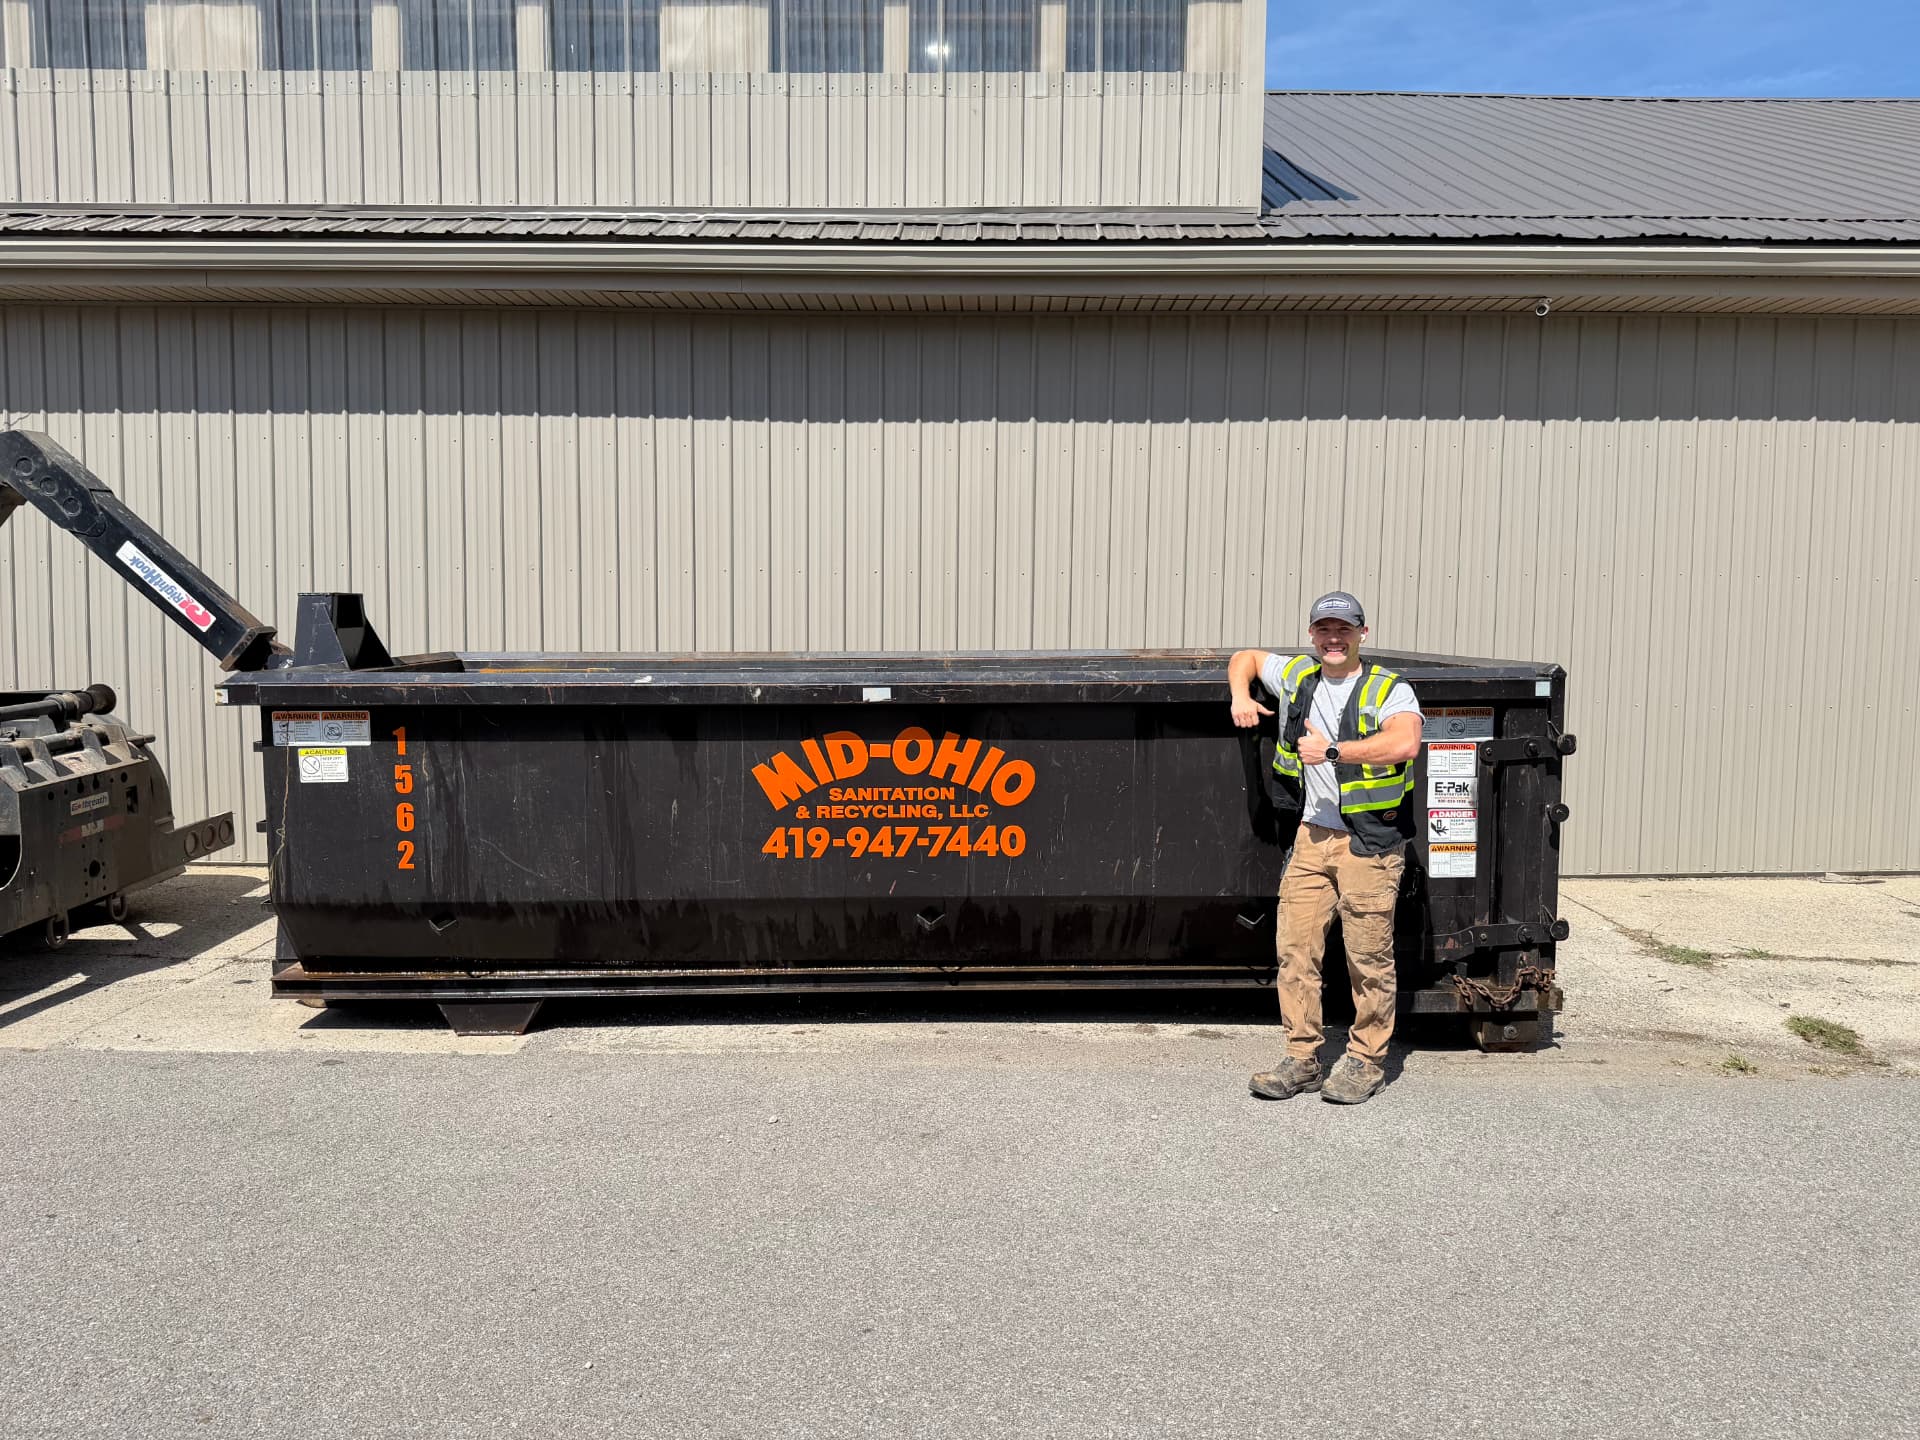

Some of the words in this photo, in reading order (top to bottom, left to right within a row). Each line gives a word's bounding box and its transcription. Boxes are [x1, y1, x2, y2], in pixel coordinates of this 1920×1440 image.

[129, 555, 184, 604] RightHook
[280, 712, 318, 720] WARNING
[327, 712, 367, 720] WARNING
[1422, 709, 1442, 717] NING
[1452, 709, 1491, 717] WARNING
[751, 726, 1036, 811] MID-OHIO
[829, 786, 955, 802] SANITATION
[1435, 782, 1470, 793] E-Pak
[795, 805, 810, 819] &
[816, 804, 943, 820] RECYCLING,
[950, 804, 990, 818] LLC
[761, 825, 1027, 859] 419-947-7440
